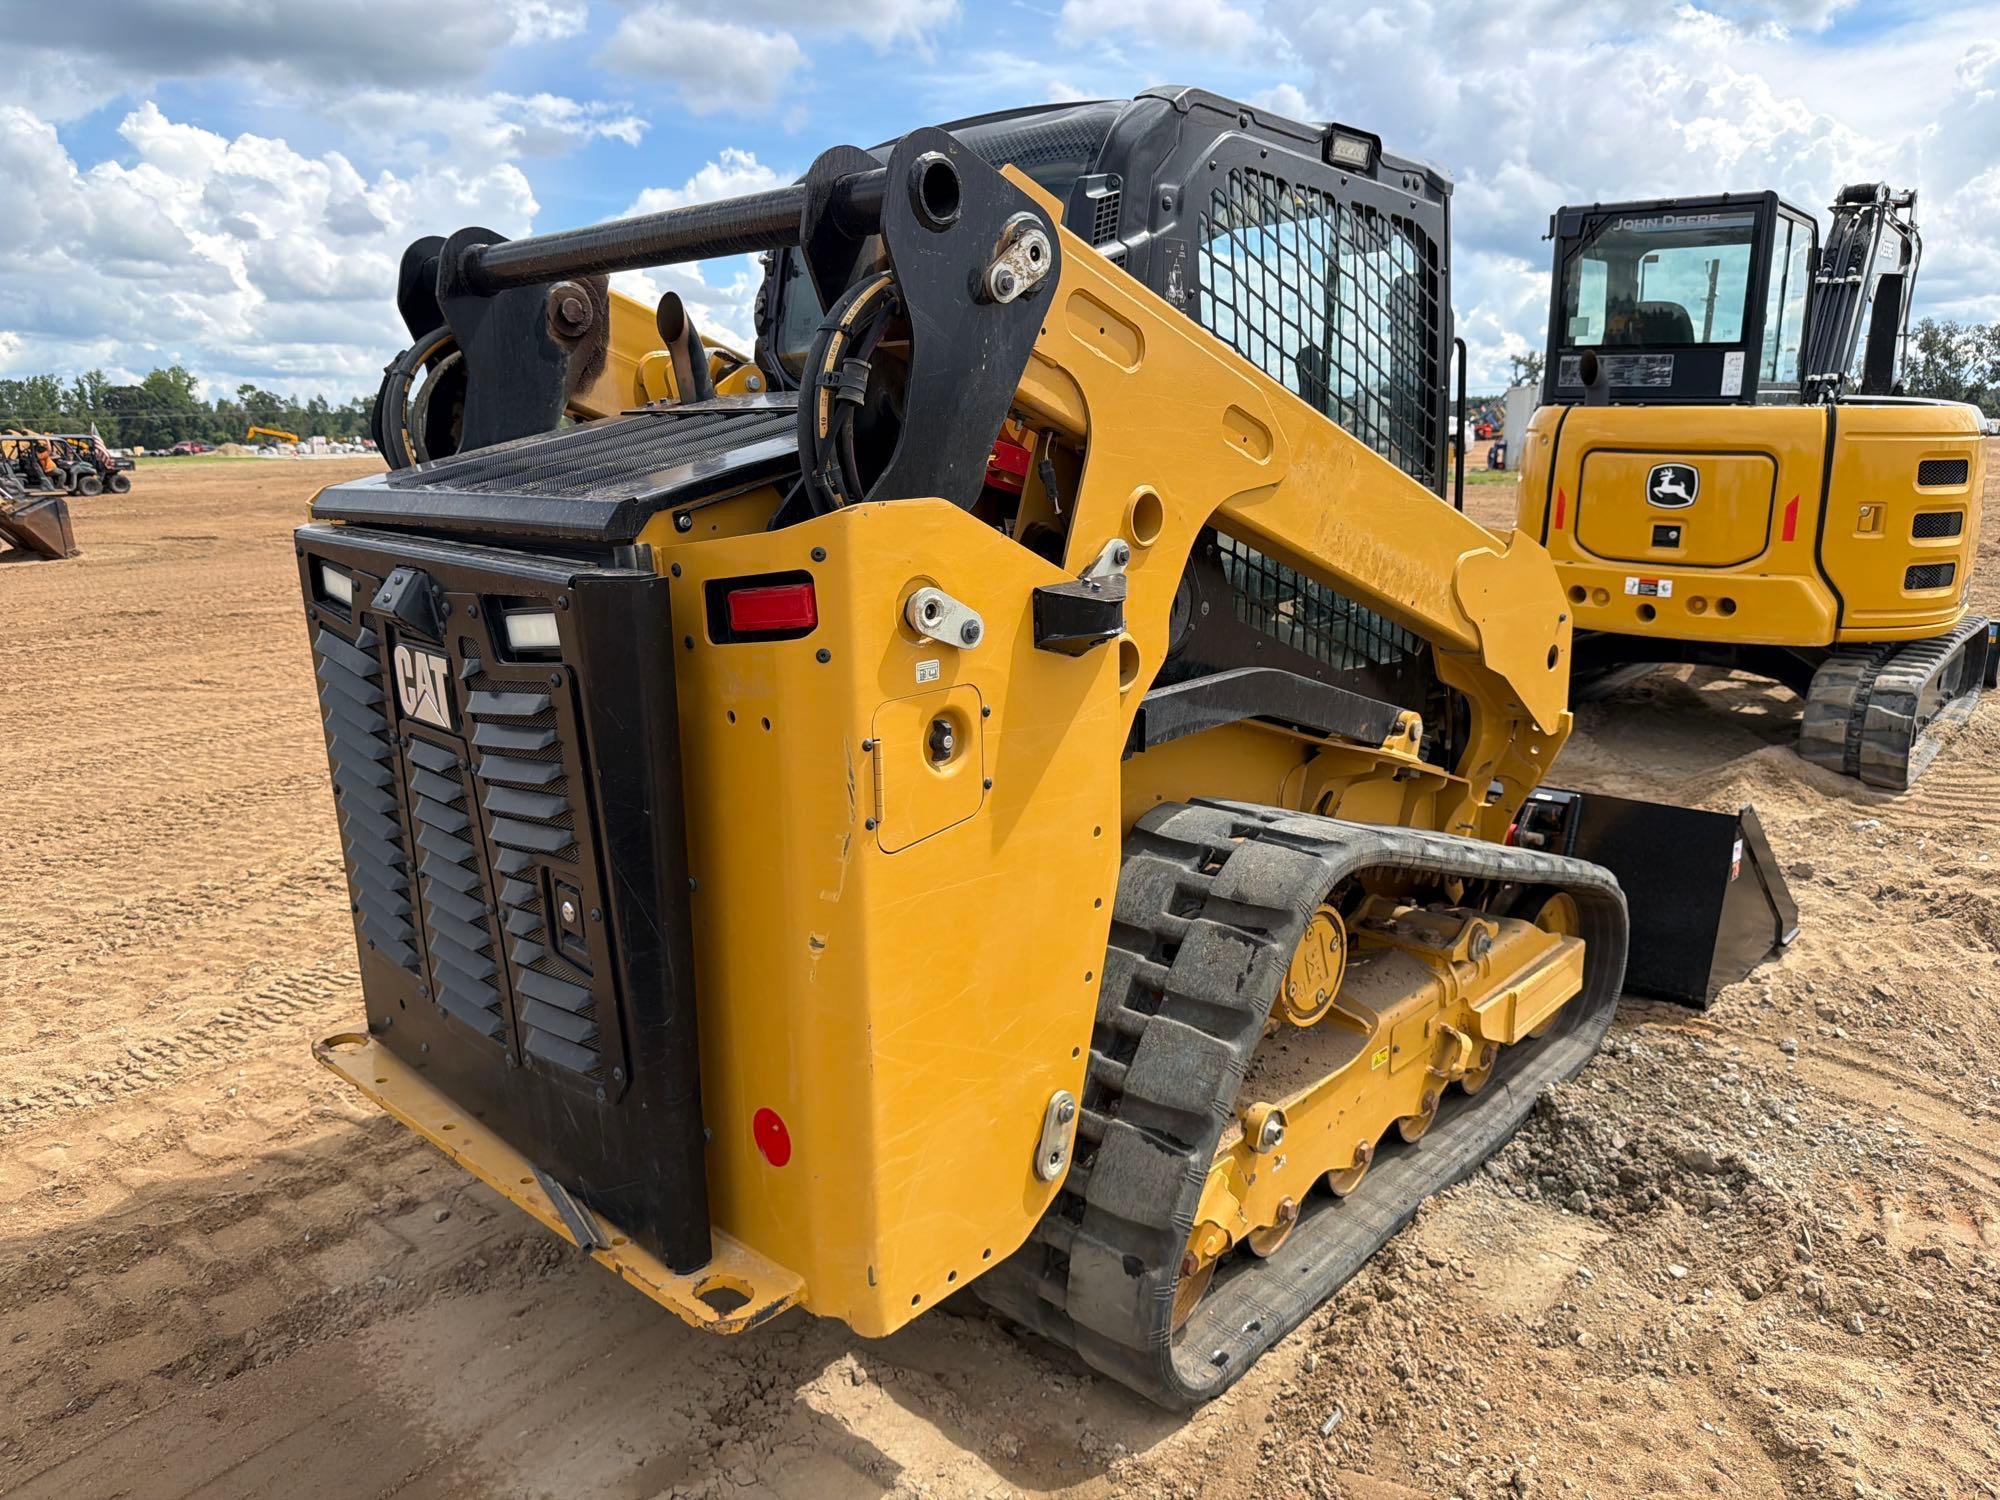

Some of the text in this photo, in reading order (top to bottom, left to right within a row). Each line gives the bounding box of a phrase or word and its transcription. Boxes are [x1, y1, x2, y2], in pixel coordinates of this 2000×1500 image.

[1613, 214, 1720, 231] JOHN DEERE
[394, 645, 452, 730] CAT
